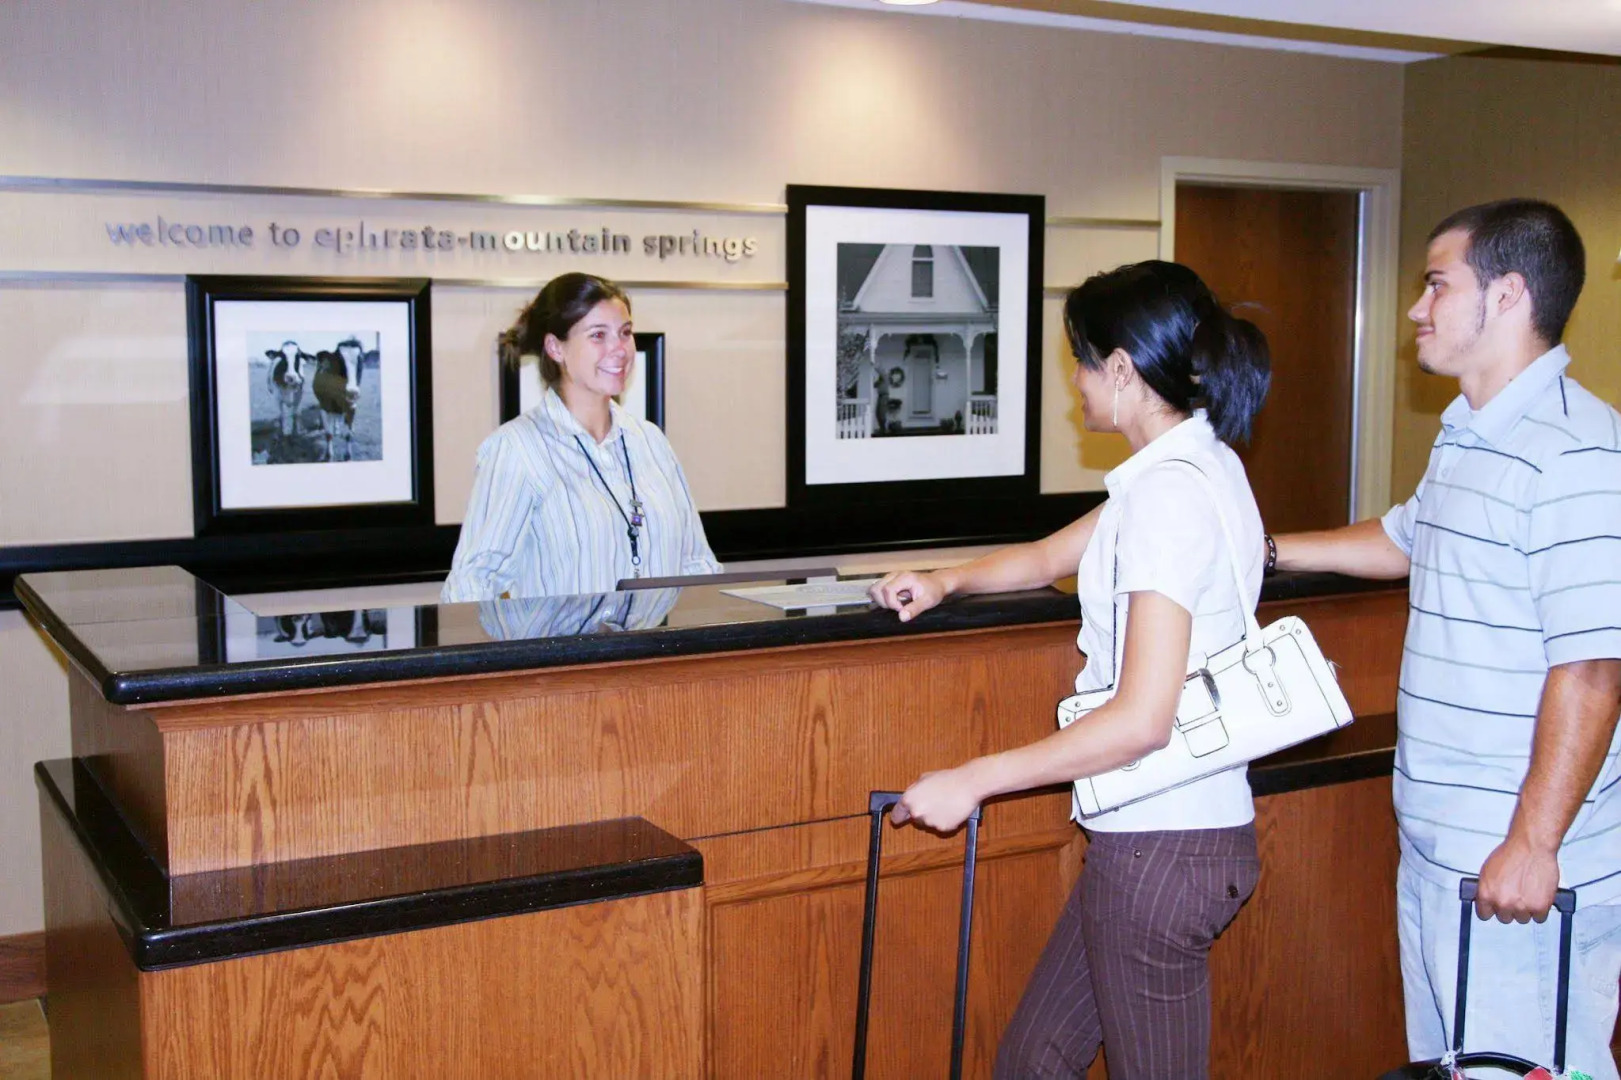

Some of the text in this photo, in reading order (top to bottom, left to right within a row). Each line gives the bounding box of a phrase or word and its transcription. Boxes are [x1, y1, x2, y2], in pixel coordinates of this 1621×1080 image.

[106, 215, 758, 261] welcome to ephrata-mountain springs
